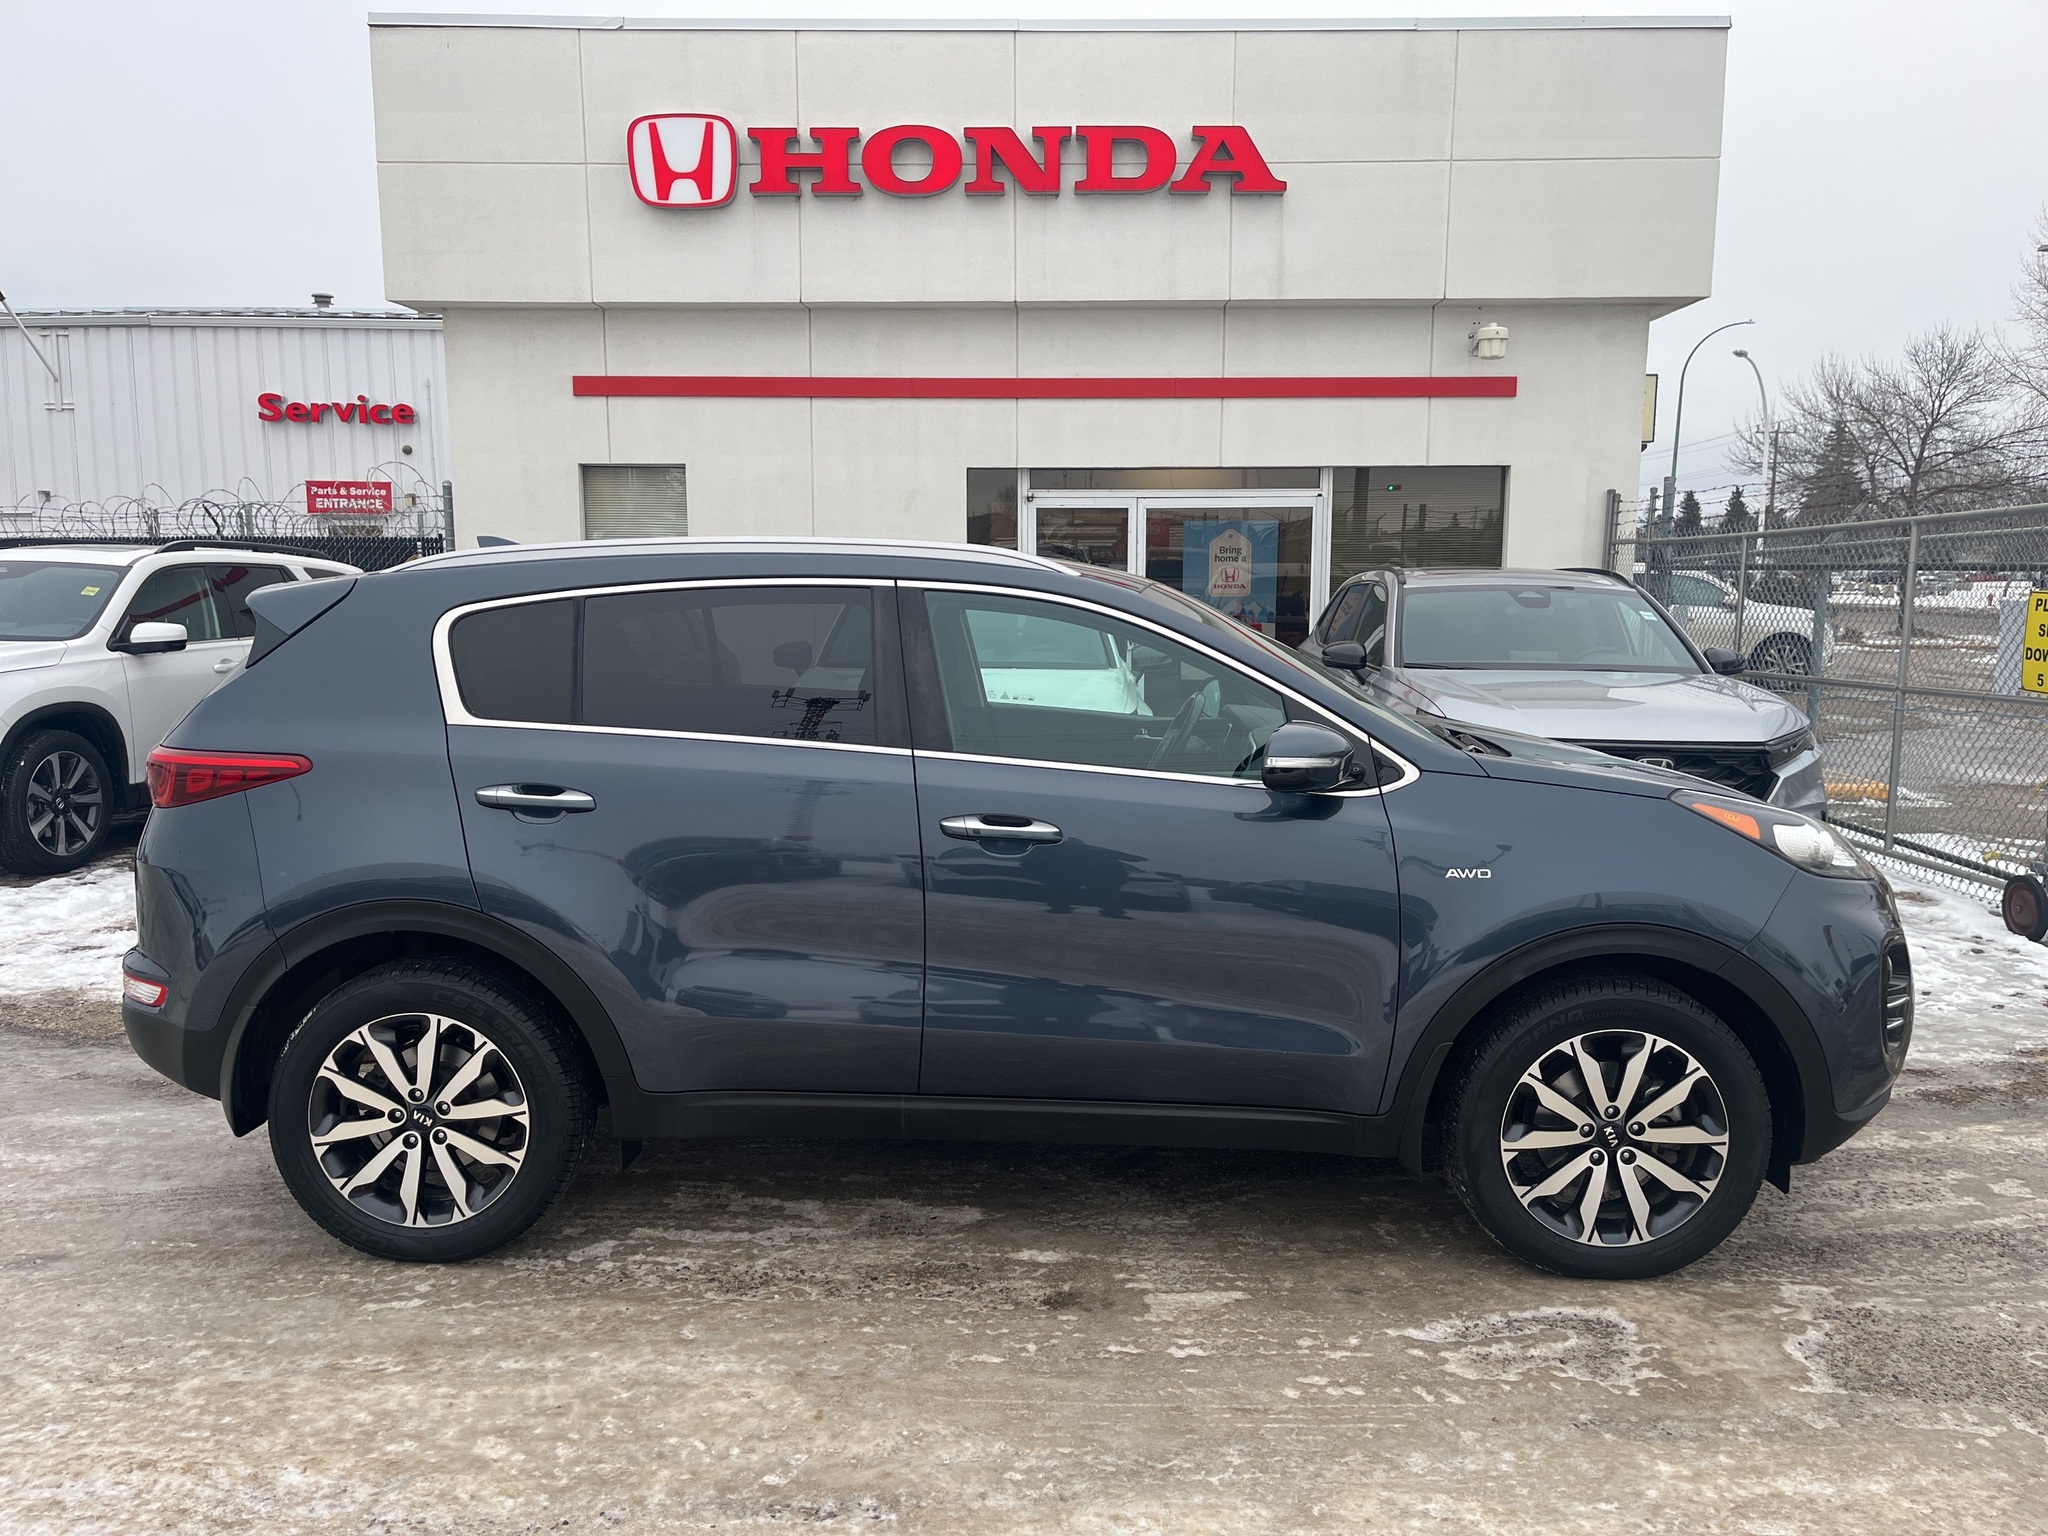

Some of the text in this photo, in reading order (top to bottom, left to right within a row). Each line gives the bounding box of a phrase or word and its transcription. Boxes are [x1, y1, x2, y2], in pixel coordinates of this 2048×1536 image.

[747, 125, 1287, 196] HONDA
[258, 392, 416, 425] Service
[311, 486, 387, 496] Parts & Service
[316, 498, 384, 509] ENTRANCE
[1219, 546, 1242, 556] Bring
[1214, 554, 1239, 563] home
[2038, 623, 2048, 637] S
[2037, 673, 2044, 687] 5
[1444, 868, 1492, 879] AWD
[412, 1110, 434, 1127] KIA
[1603, 1125, 1619, 1148] KIA
